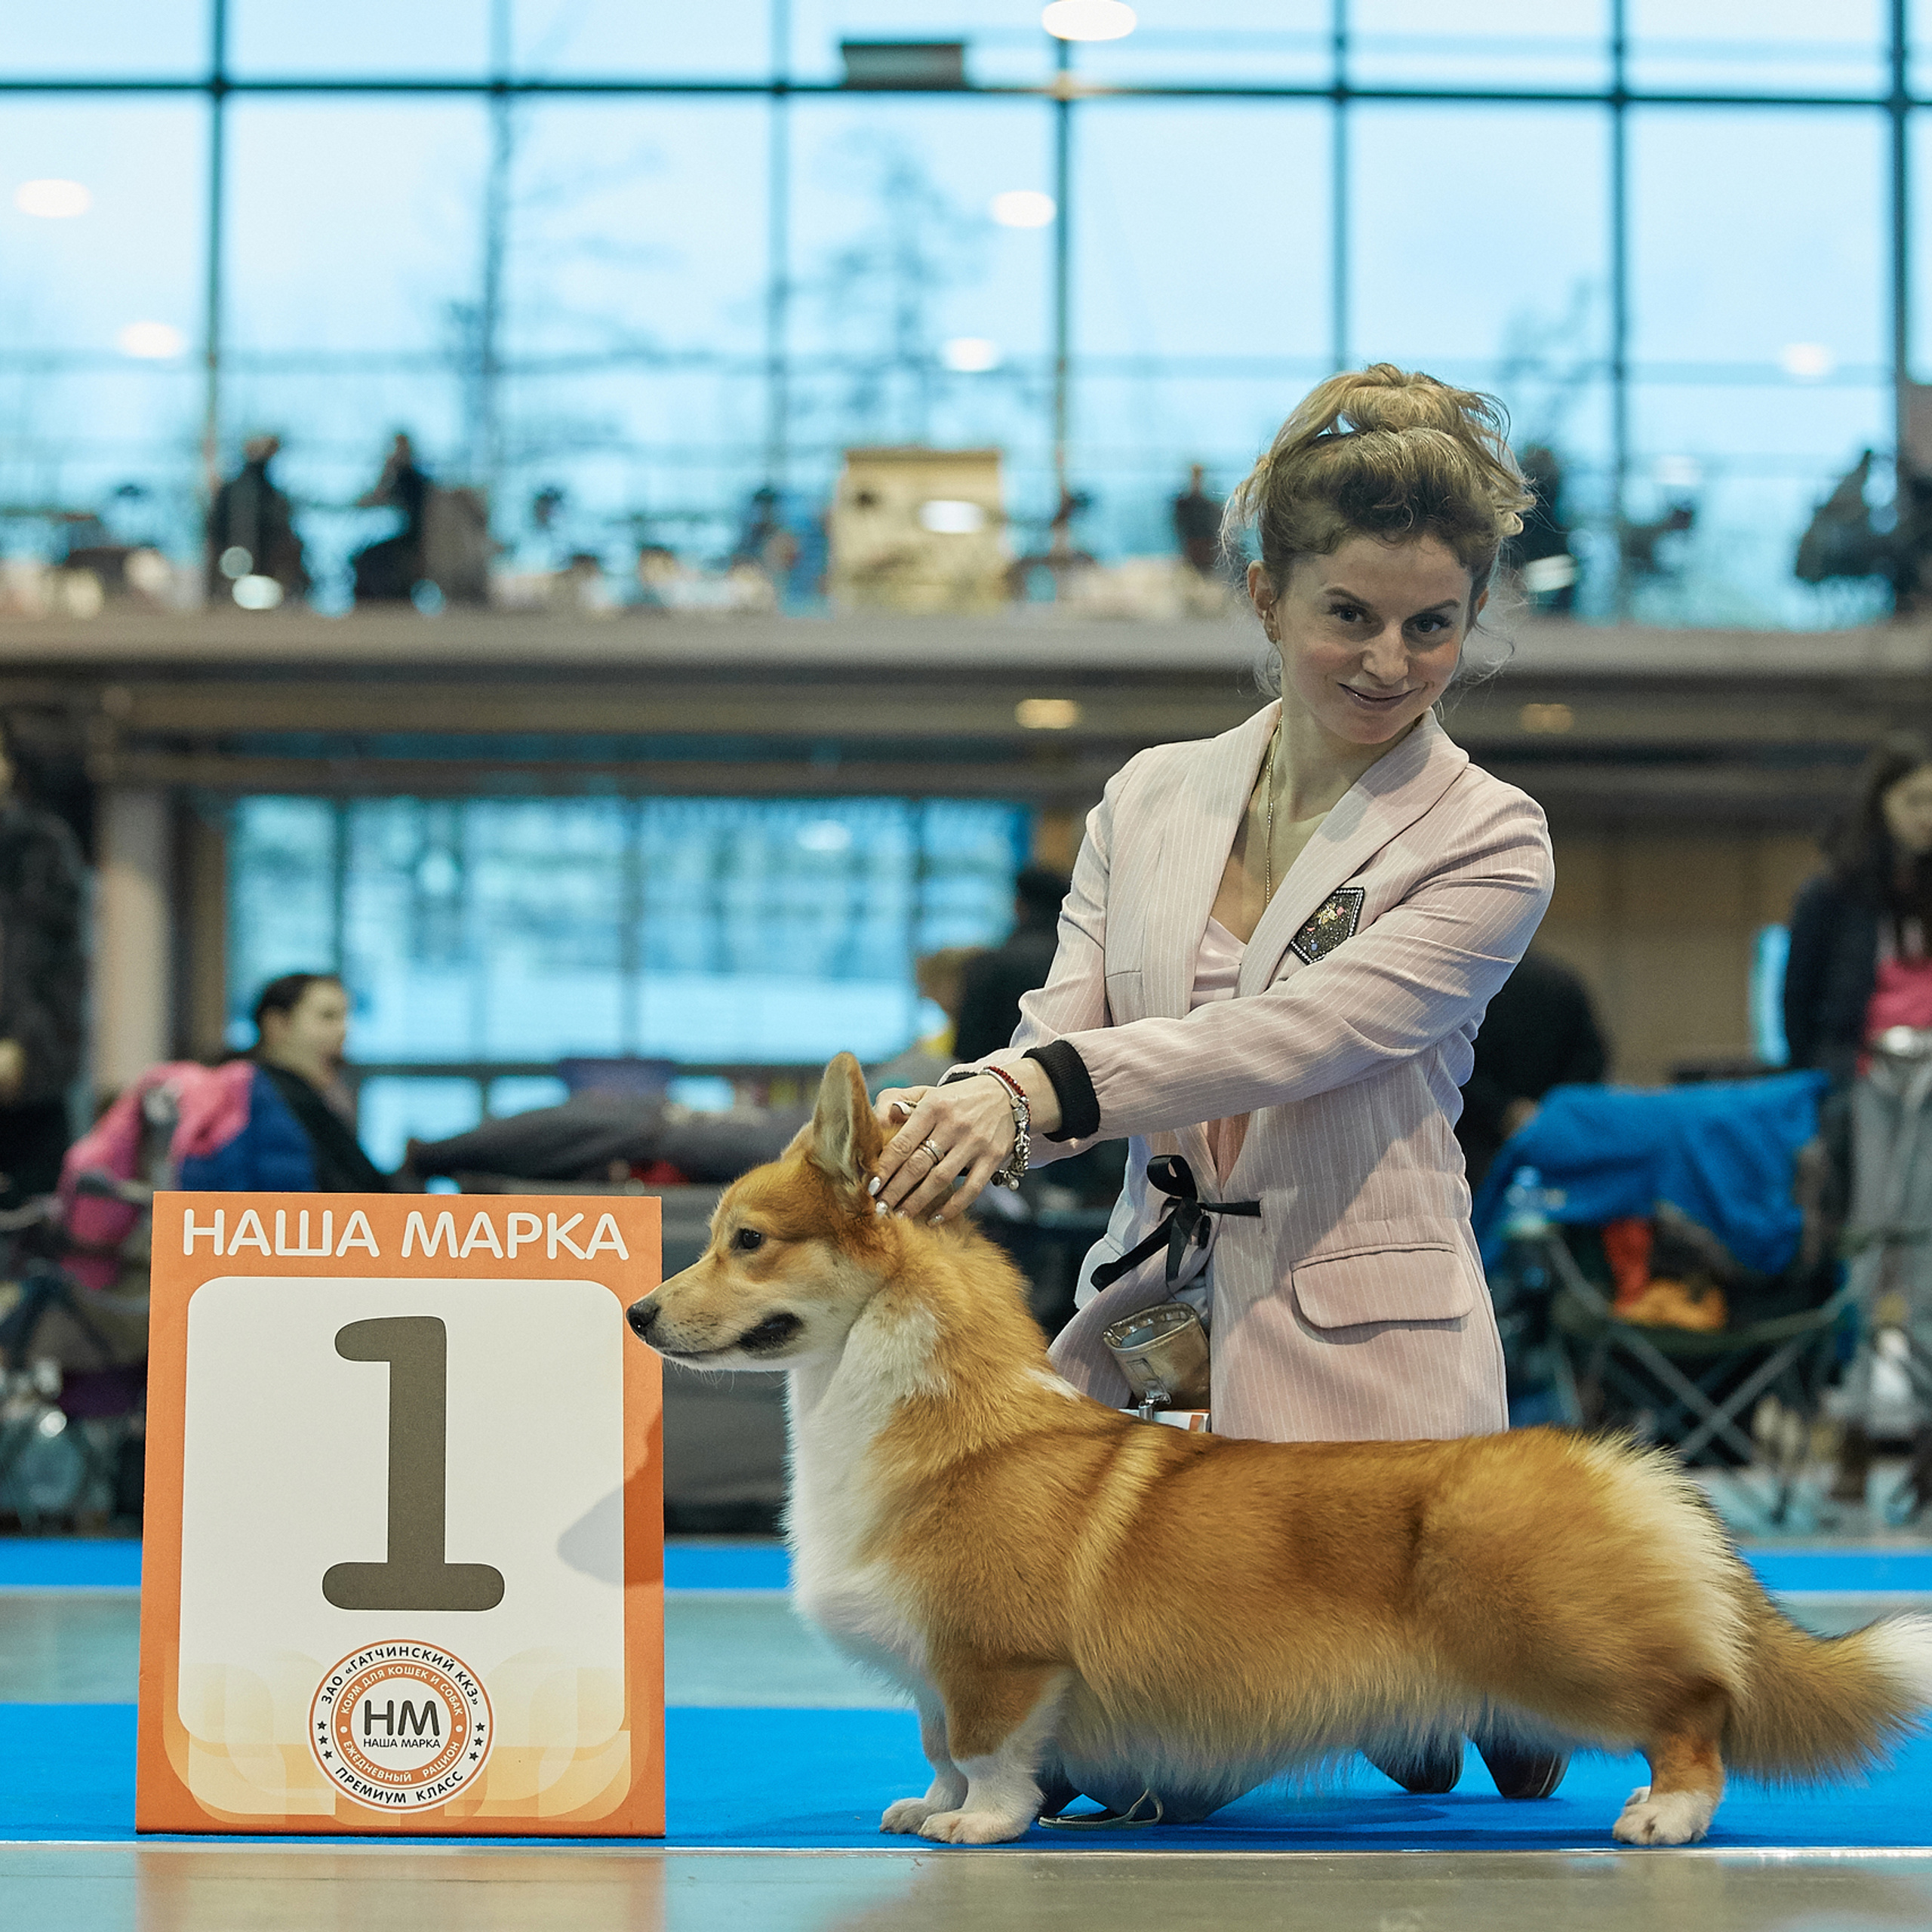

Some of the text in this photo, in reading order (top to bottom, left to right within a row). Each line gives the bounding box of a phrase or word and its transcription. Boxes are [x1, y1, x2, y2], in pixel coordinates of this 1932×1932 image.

[183, 1209, 629, 1260] НАША МАРКА
[322, 1315, 505, 1611] 1
[321, 1646, 478, 1705] ЗАО «ГАТЧИНСКИЙ ККЗ»
[340, 1666, 463, 1716] КОРМ ДЛЯ КОШЕК И СОБАК
[364, 1700, 441, 1737] НМ
[343, 1740, 460, 1783] ЕЖЕДНЕВНЫЙ РАЦИОН
[364, 1738, 441, 1749] НАША МАРКА
[335, 1767, 463, 1804] ПРЕМИУМ КЛАСС
